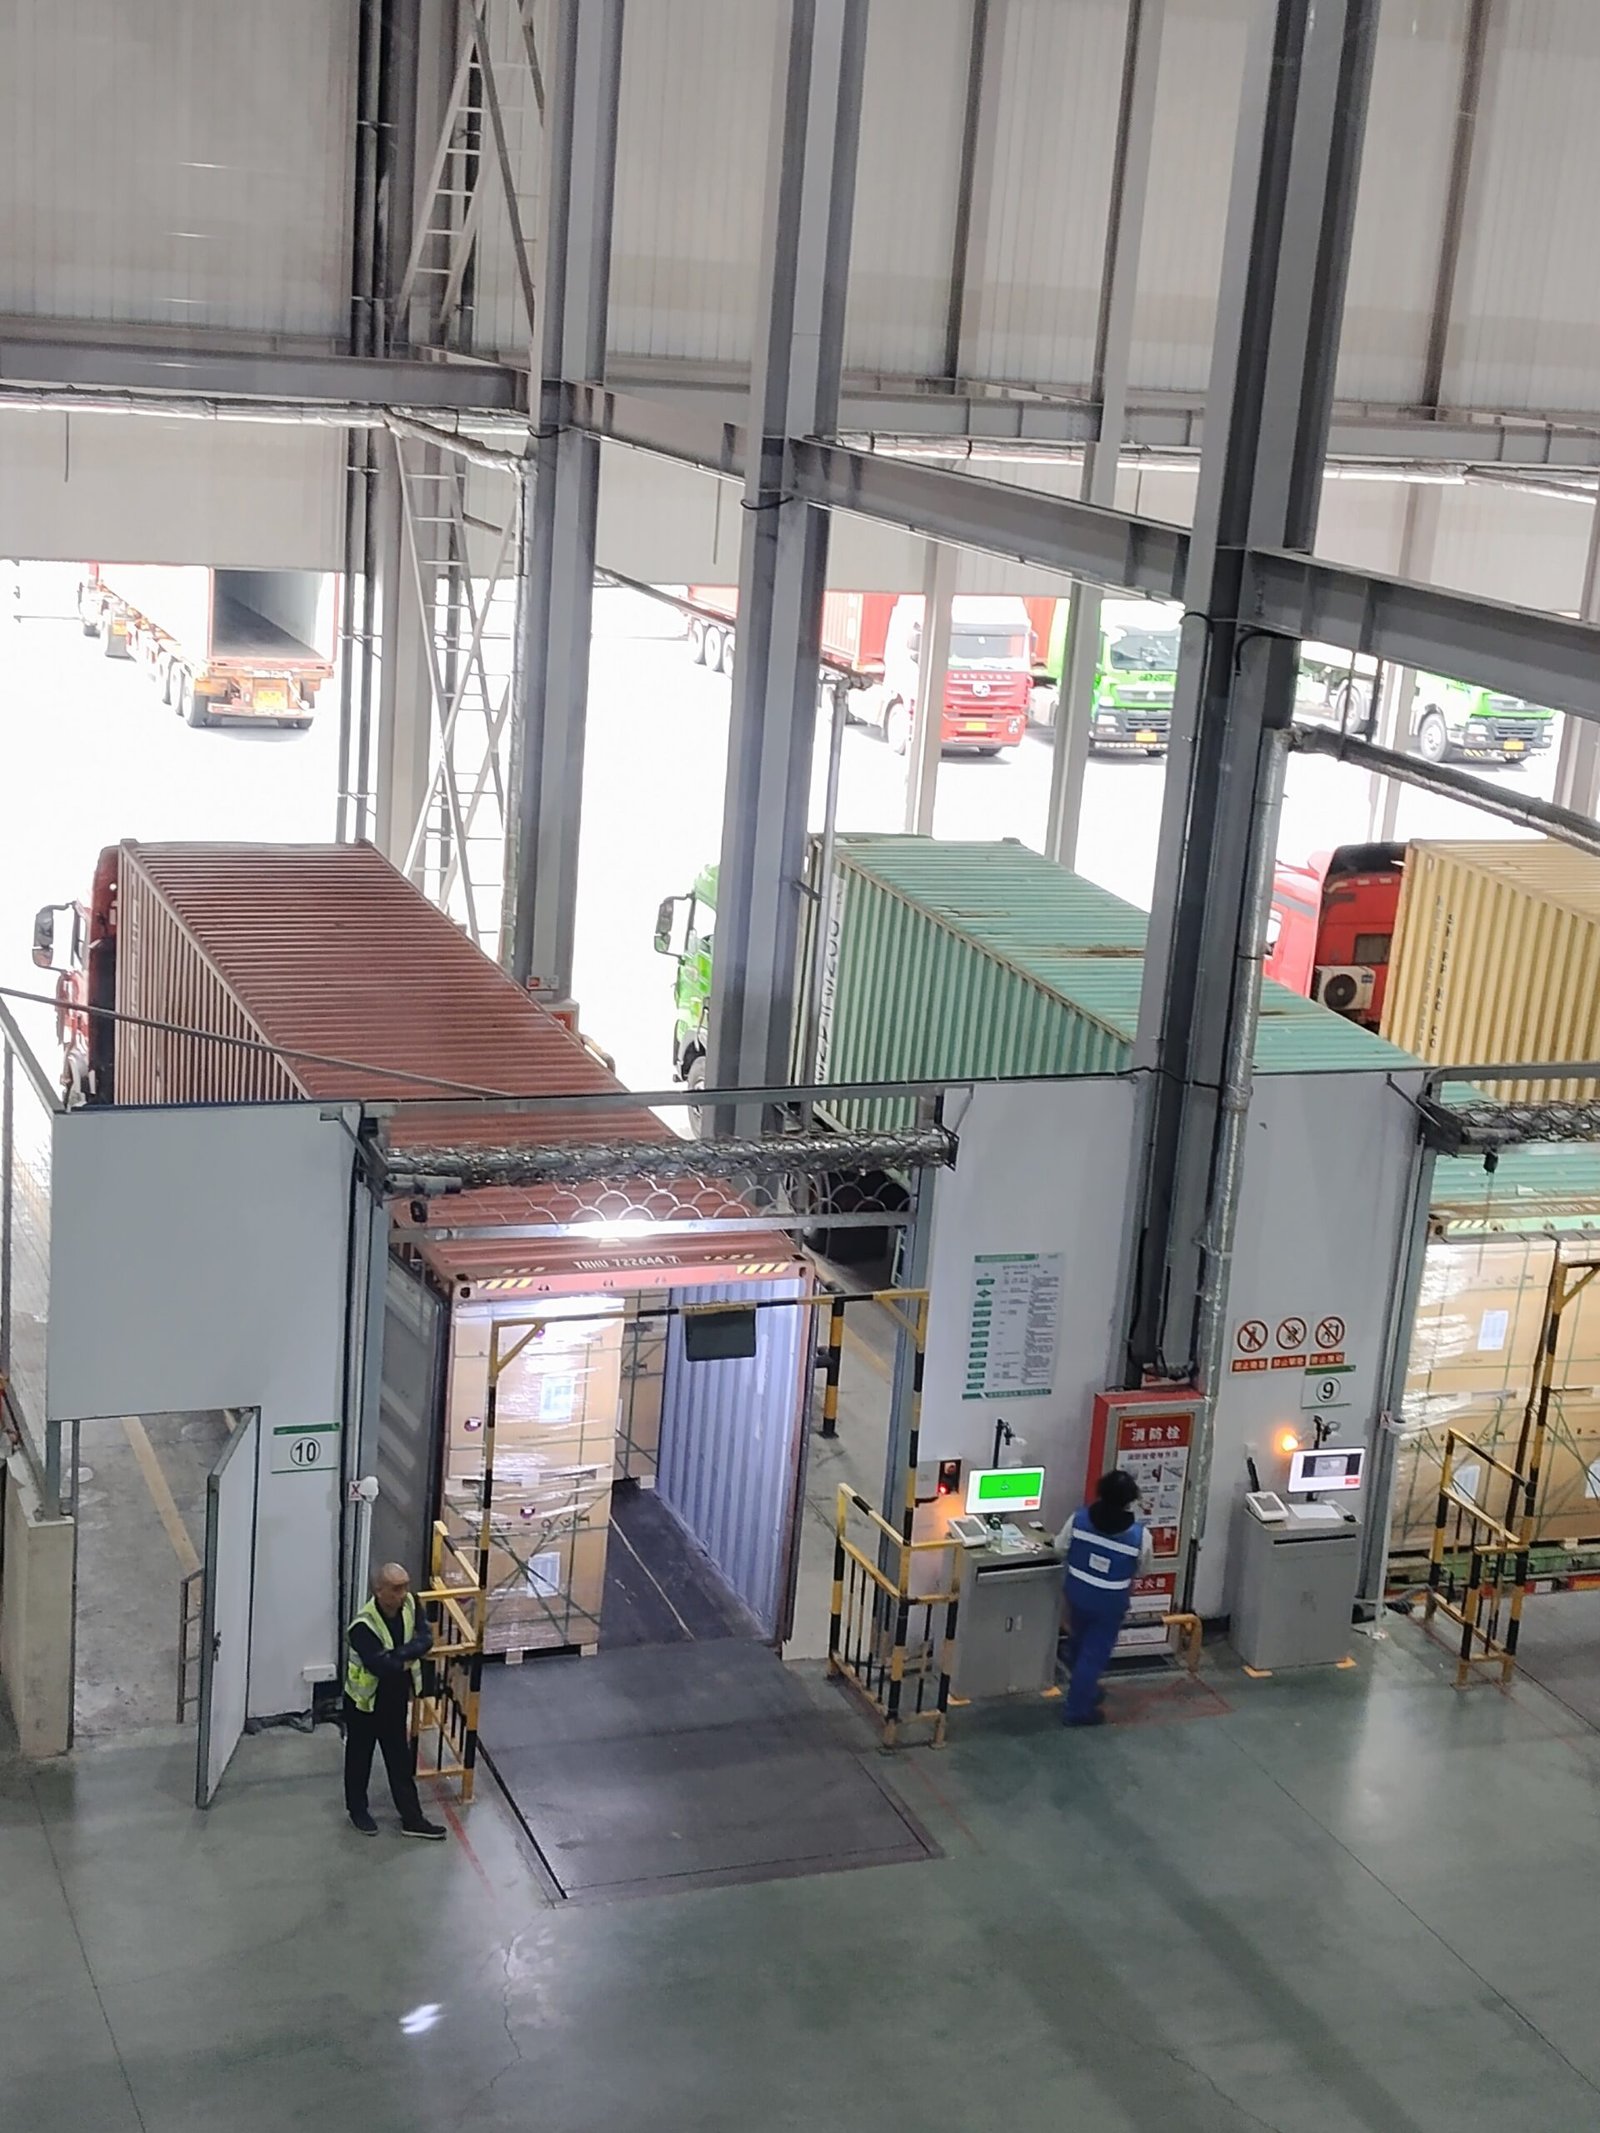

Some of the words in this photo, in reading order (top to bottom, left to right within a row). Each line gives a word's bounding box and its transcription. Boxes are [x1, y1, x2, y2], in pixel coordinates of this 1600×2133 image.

[573, 1260, 609, 1270] TRHU
[612, 1256, 664, 1267] 722644
[1321, 1381, 1334, 1399] 9
[295, 1442, 317, 1462] 10
